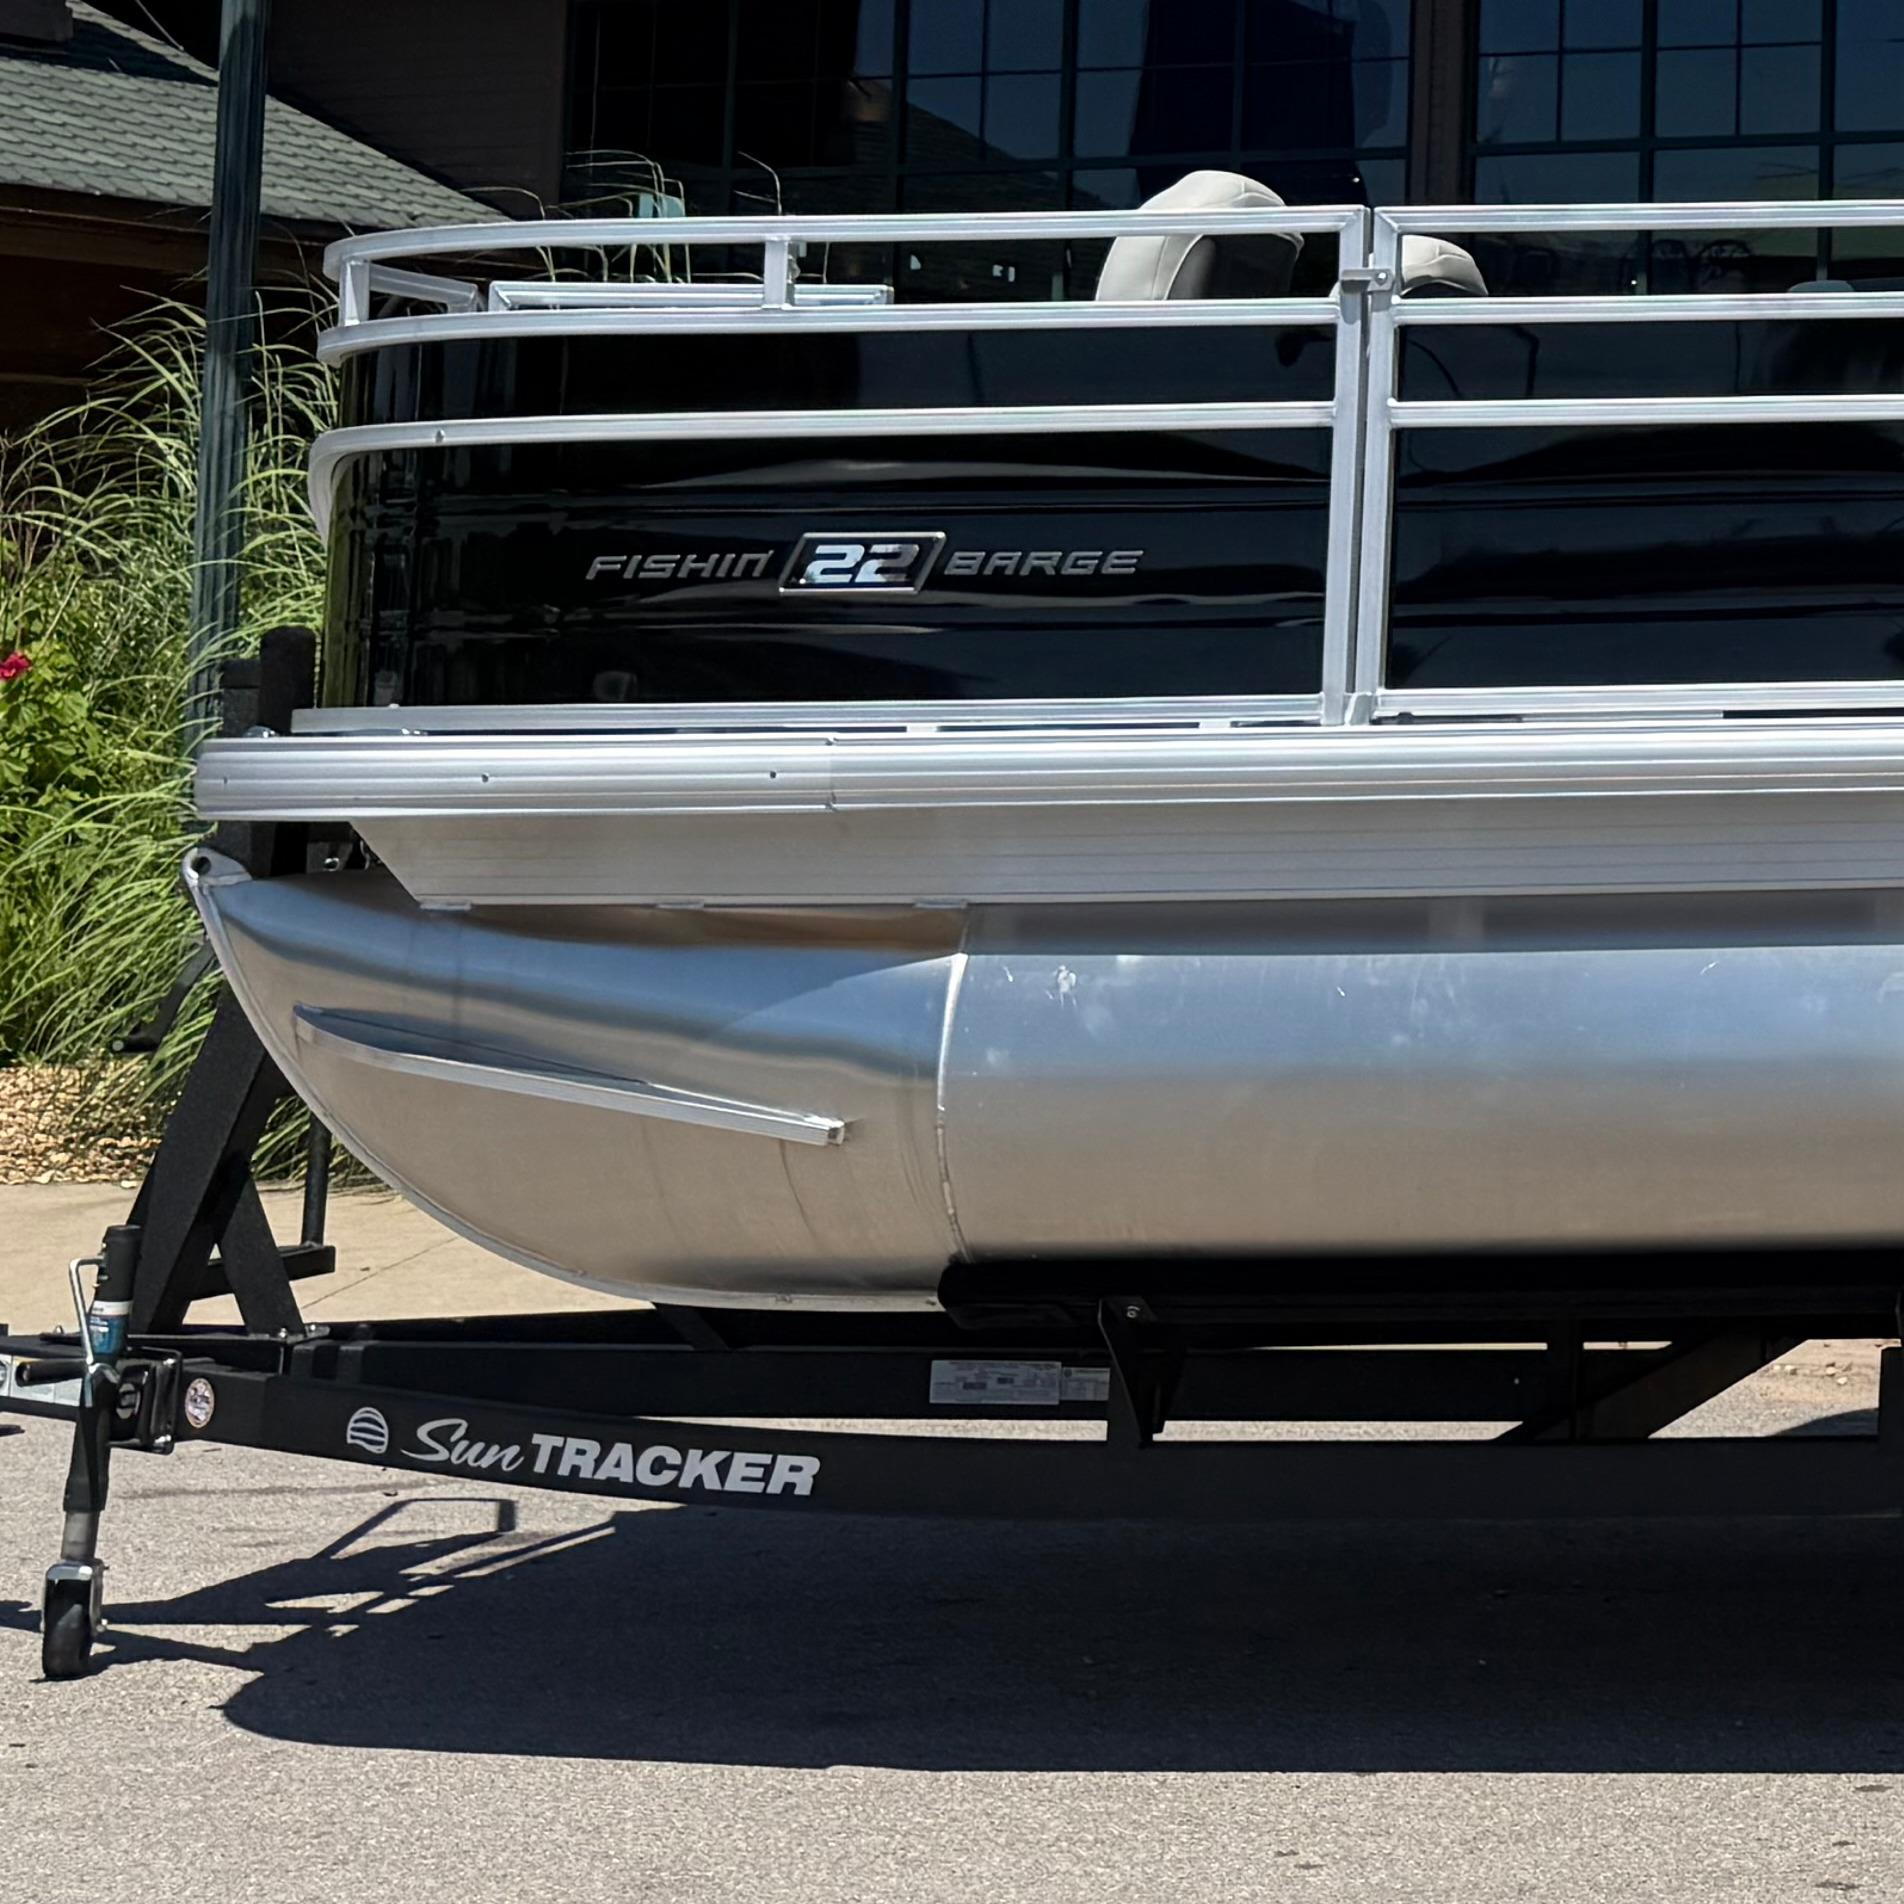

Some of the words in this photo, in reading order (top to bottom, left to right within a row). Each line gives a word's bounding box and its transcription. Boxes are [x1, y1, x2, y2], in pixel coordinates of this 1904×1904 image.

[805, 544, 920, 584] 22
[943, 549, 1145, 577] BARGE
[401, 1418, 523, 1472] Sun
[531, 1432, 821, 1496] TRACKER
